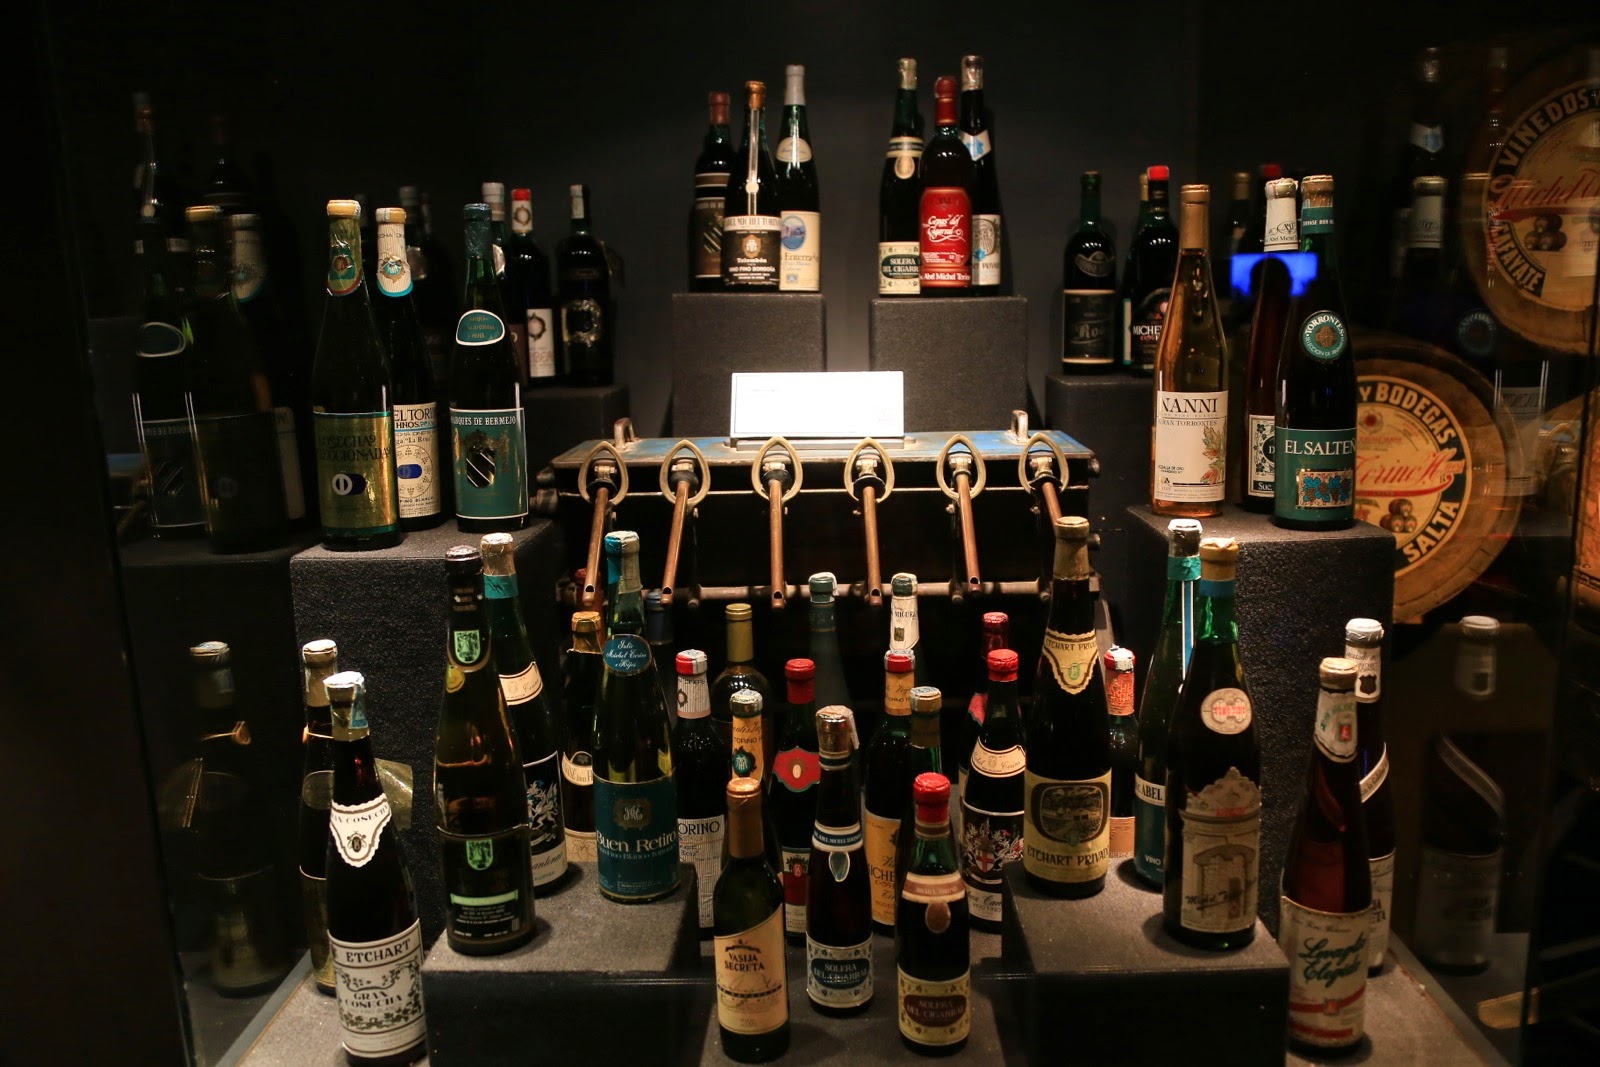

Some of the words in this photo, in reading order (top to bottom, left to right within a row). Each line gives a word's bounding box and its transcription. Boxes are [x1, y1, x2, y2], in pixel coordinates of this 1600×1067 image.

[890, 257, 916, 265] SOLERA
[1304, 314, 1345, 335] TORRONTES
[473, 416, 484, 426] DE
[485, 415, 516, 426] BERMEJO
[1375, 382, 1458, 445] BODEGAS
[1176, 419, 1218, 427] TORRONTES
[1284, 439, 1303, 455] EL
[1402, 501, 1460, 563] SALTA
[1141, 784, 1163, 801] ABEL
[596, 829, 630, 853] Buen
[636, 830, 677, 853] Retiro
[1027, 844, 1073, 867] ETCHART
[1145, 854, 1162, 866] VINO
[346, 939, 411, 964] ETCHART
[728, 952, 758, 963] VASIJA
[724, 961, 765, 973] SECRETA
[824, 962, 858, 973] SOLERA
[345, 994, 403, 1009] COSECHA
[353, 990, 389, 1001] GRAN
